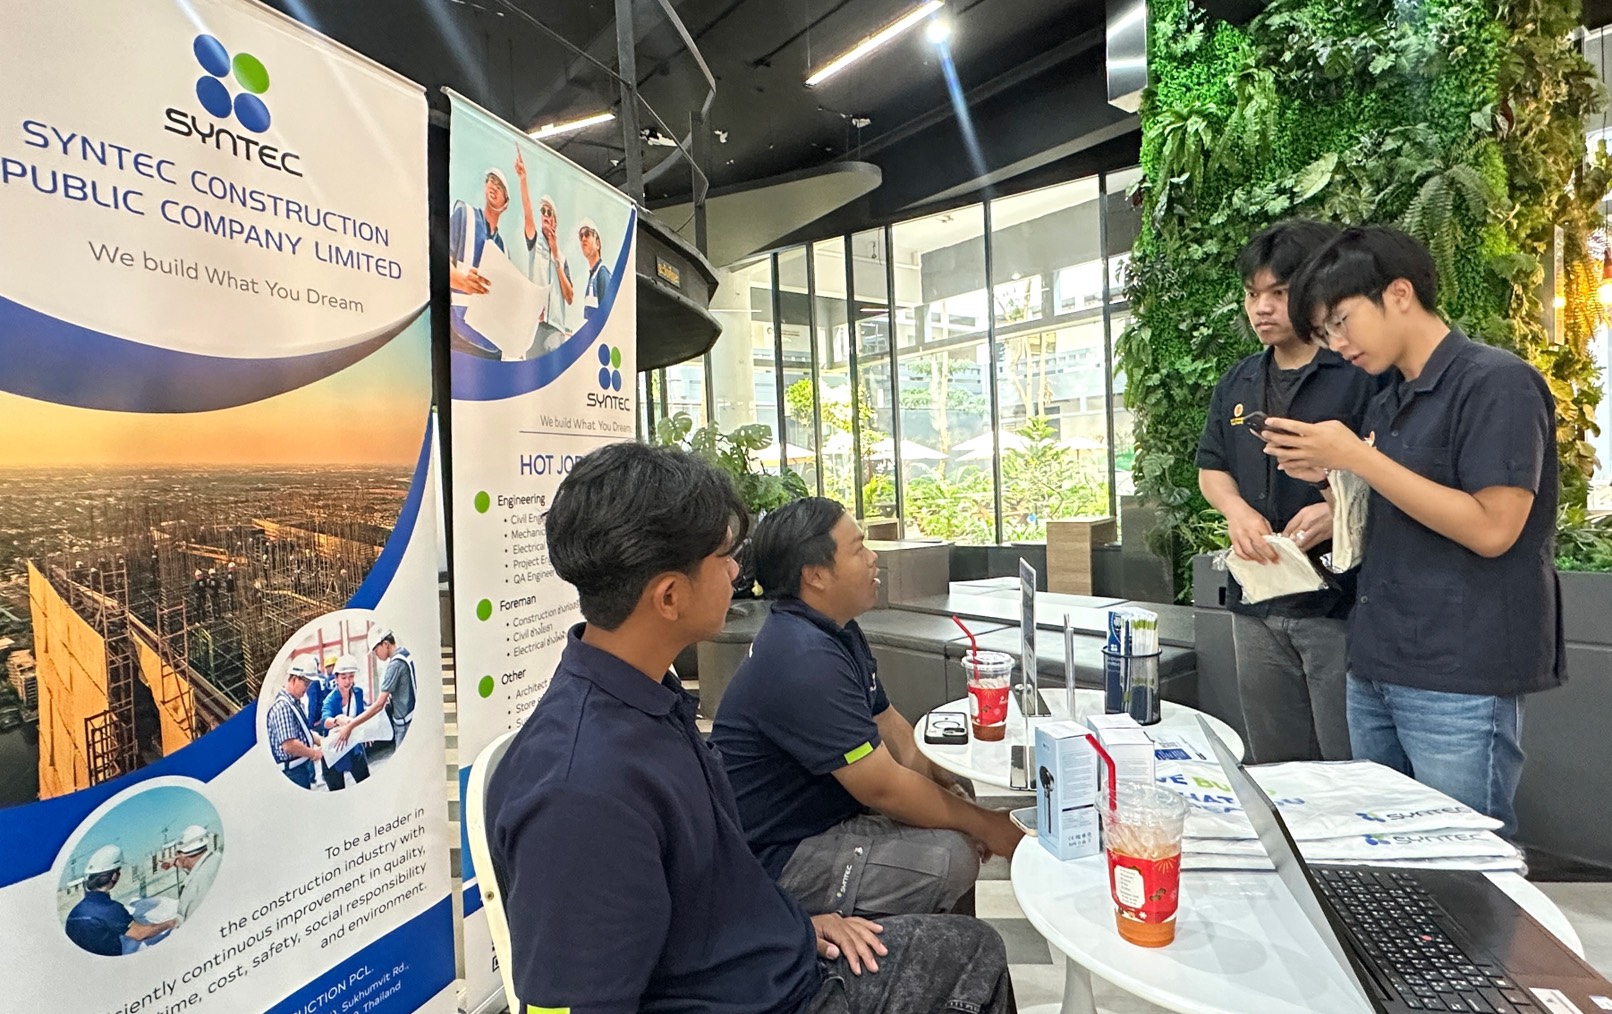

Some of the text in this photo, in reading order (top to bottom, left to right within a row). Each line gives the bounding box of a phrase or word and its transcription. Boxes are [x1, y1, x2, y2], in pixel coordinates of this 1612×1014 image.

[164, 107, 303, 178] SYNTEC
[22, 119, 390, 247] SYNTEC CONSTRUCTION
[1, 157, 402, 280] PUBLIC COMPANY LIMITED
[88, 240, 364, 313] We build What You Dream
[586, 392, 630, 411] SYNTEC
[540, 414, 553, 427] We
[555, 416, 572, 428] build
[573, 418, 596, 430] What
[598, 420, 611, 431] You
[520, 454, 554, 475] HOT
[498, 493, 546, 509] Engineering
[511, 513, 527, 525] Civil
[512, 528, 546, 539] Mechanic
[513, 541, 545, 555] Electrical
[514, 557, 540, 570] Project
[514, 573, 526, 584] QA
[499, 595, 537, 612] Foreman
[513, 608, 557, 627] Construction
[513, 631, 529, 642] Civil
[514, 638, 546, 657] Electrical
[501, 669, 526, 685] Other
[516, 680, 548, 699] Architect
[516, 699, 536, 714] Store
[1387, 806, 1472, 820] SYNTEC
[326, 806, 424, 859] To be a leader in
[1393, 833, 1490, 845] SYNTEC
[220, 824, 425, 938] the construction industry with
[320, 882, 427, 950] and environment.
[107, 844, 426, 1014] iently continuous improvement in quality,
[157, 861, 427, 1014] ime, cost, safety, social responsibility
[293, 965, 374, 1014] UCTION PCL.
[342, 973, 390, 1012] Sukhumvit
[363, 980, 401, 1013] Thailand
